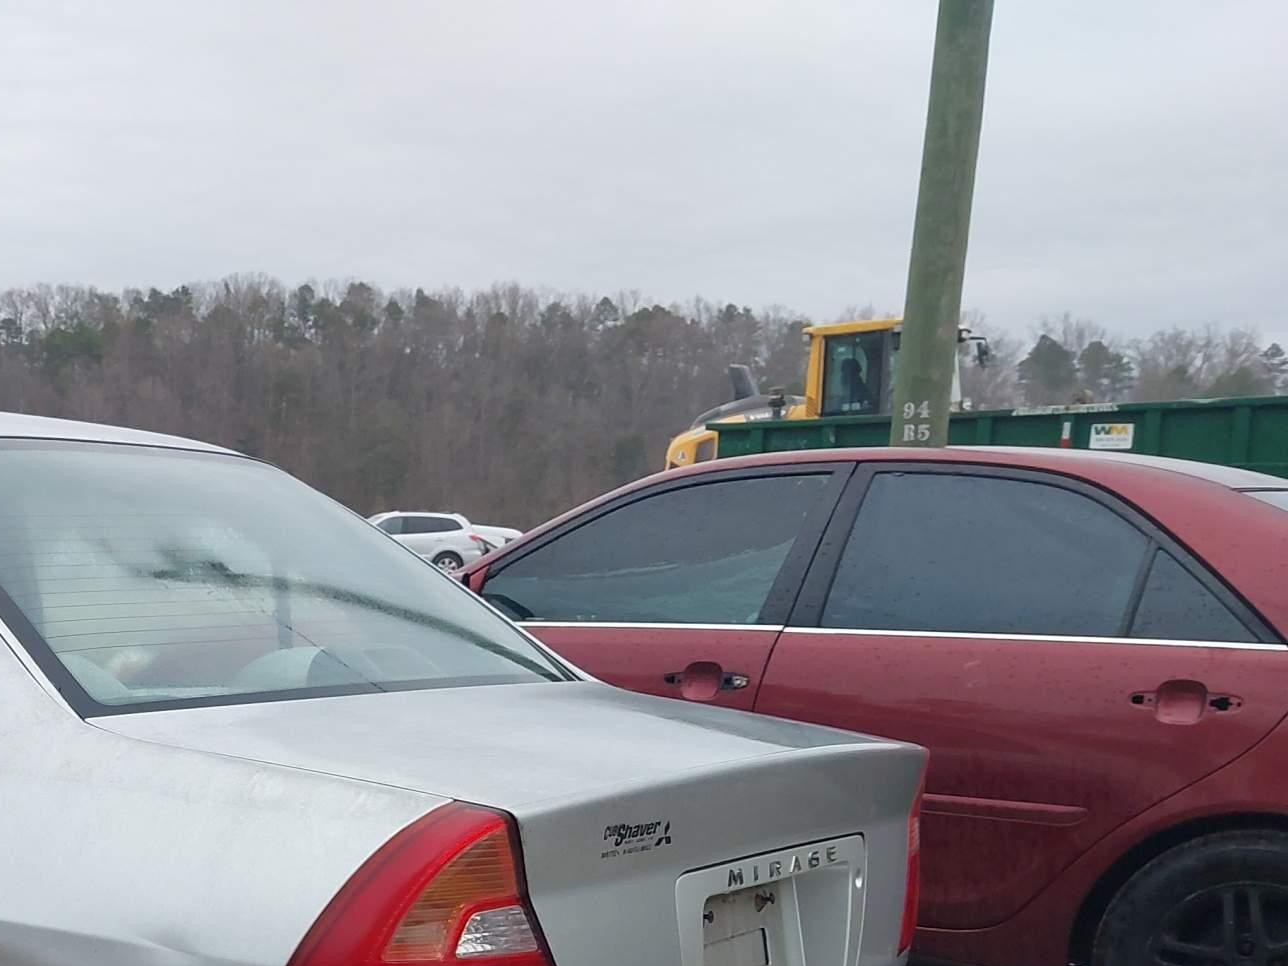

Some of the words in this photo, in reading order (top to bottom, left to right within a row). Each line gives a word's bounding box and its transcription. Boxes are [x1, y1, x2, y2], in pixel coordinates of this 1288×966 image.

[903, 401, 931, 420] 94
[902, 424, 930, 442] R5
[1094, 425, 1129, 436] WM
[727, 845, 838, 888] MIRAGE
